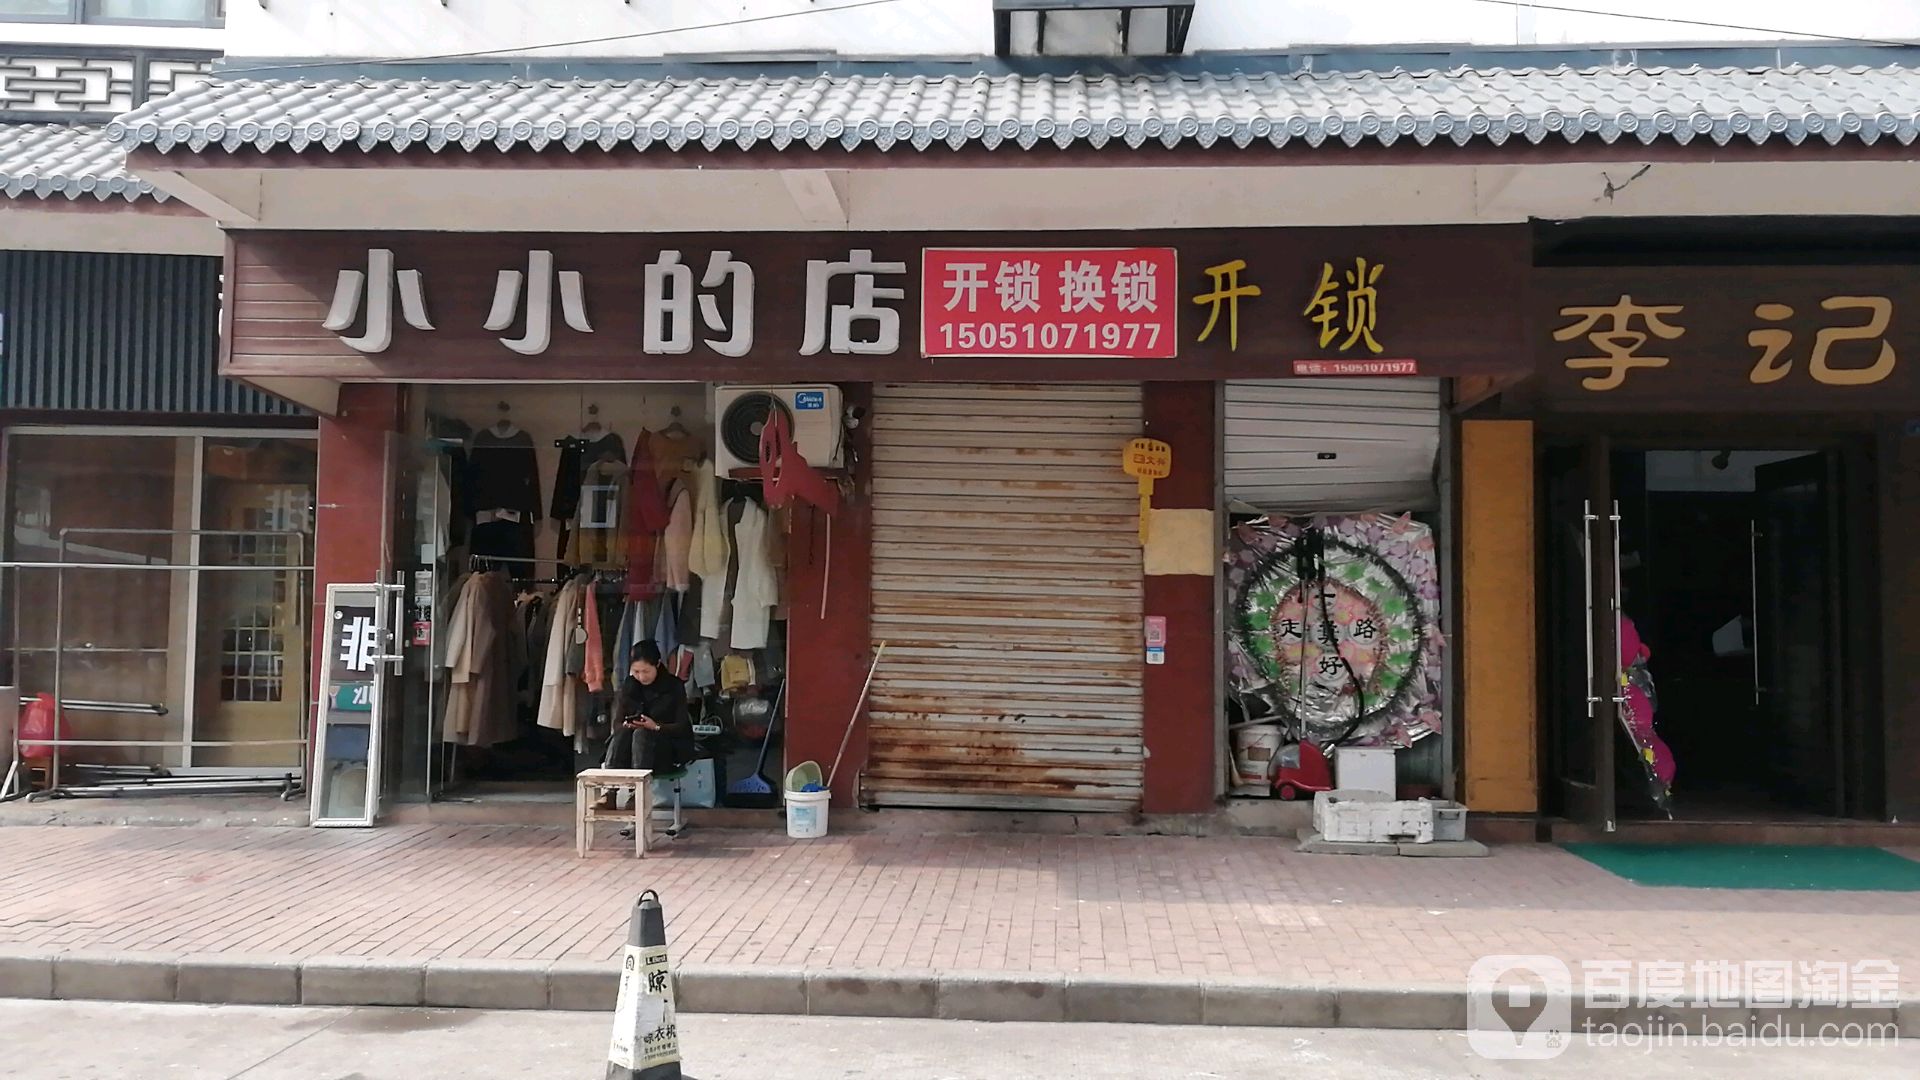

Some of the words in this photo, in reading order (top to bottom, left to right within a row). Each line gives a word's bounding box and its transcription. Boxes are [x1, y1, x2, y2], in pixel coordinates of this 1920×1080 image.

[322, 249, 906, 356] 小小的店
[942, 261, 1041, 313] 开锁
[1058, 259, 1158, 313] 换锁
[1192, 257, 1385, 354] 开锁
[939, 322, 1162, 351] 15051071977
[1552, 294, 1896, 391] 李记
